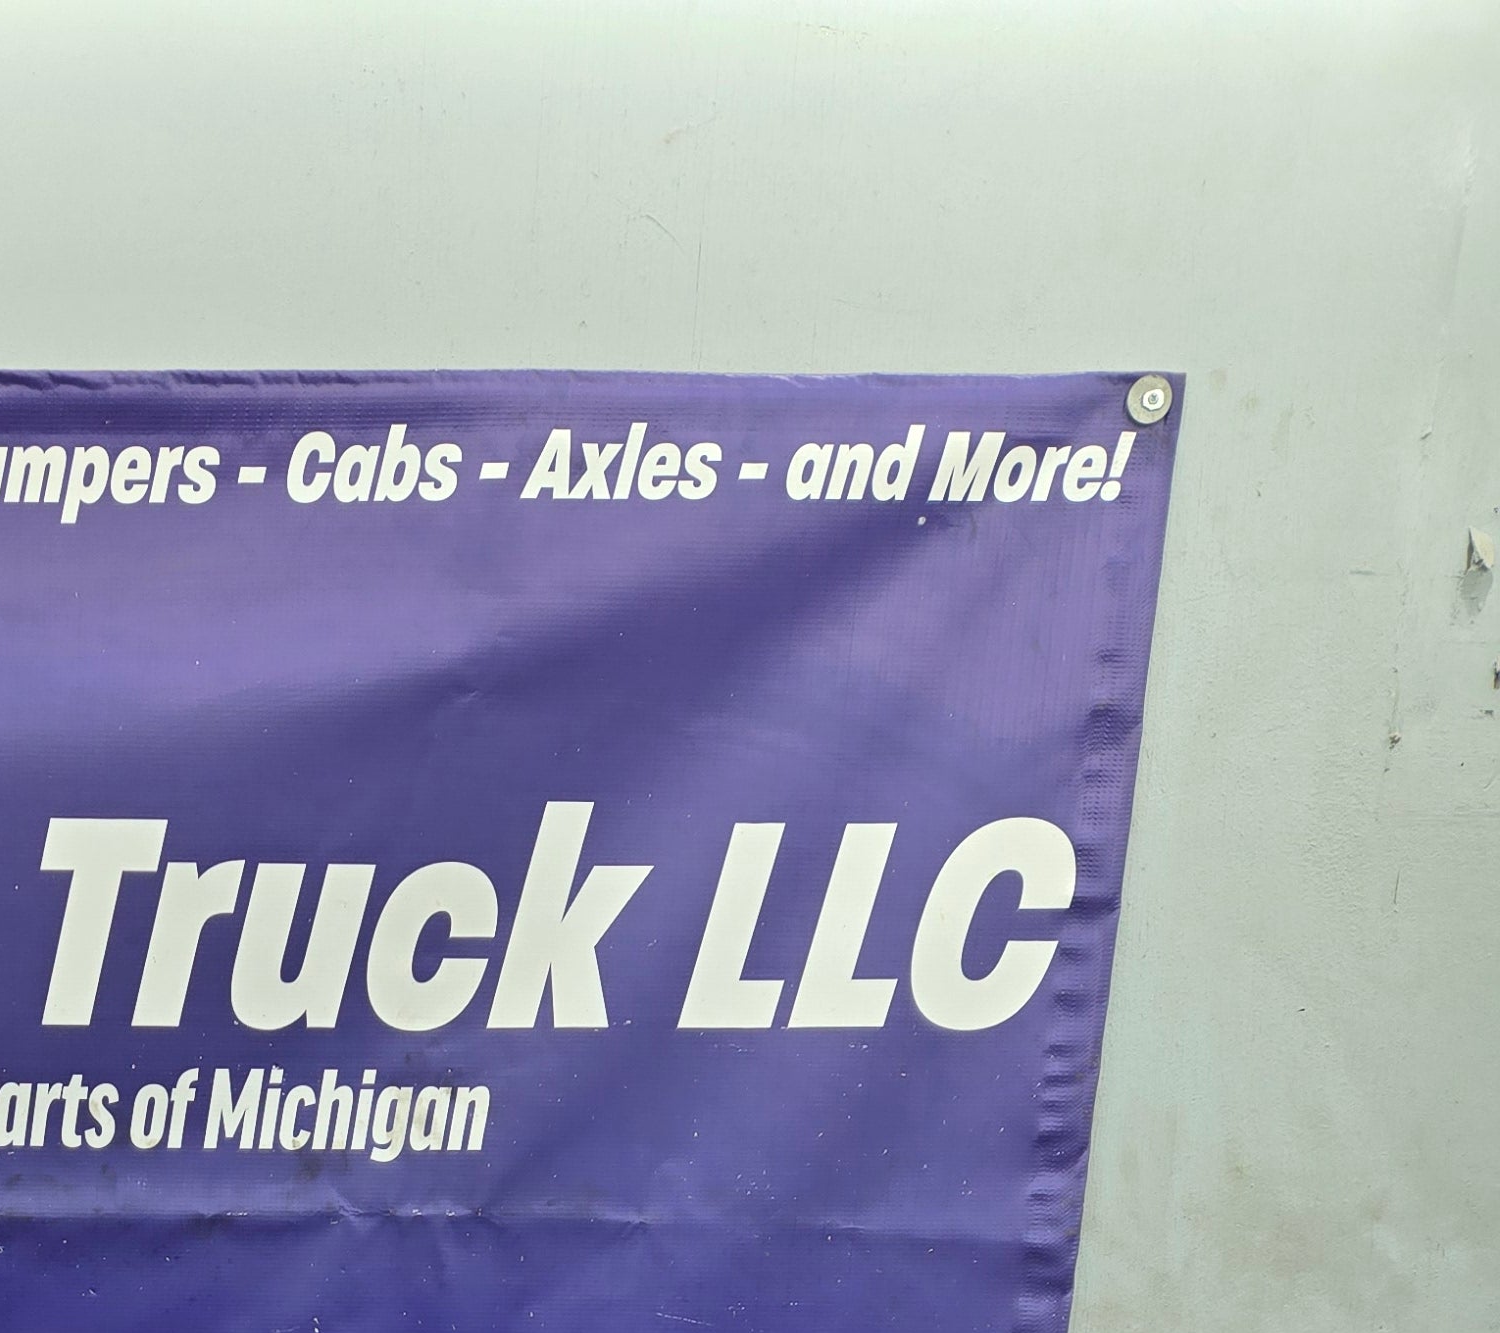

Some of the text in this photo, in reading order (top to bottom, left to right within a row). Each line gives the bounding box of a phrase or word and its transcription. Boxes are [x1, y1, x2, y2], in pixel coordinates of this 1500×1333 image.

[237, 466, 268, 485] -
[286, 424, 462, 504] Cabs
[478, 461, 510, 481] -
[519, 422, 722, 502] Axles
[737, 461, 770, 481] -
[786, 424, 926, 502] and
[927, 430, 1138, 504] More!
[40, 800, 654, 1032] Truck
[676, 816, 1077, 1032] LLC
[129, 1067, 199, 1150] of
[203, 1066, 491, 1163] Michigan
